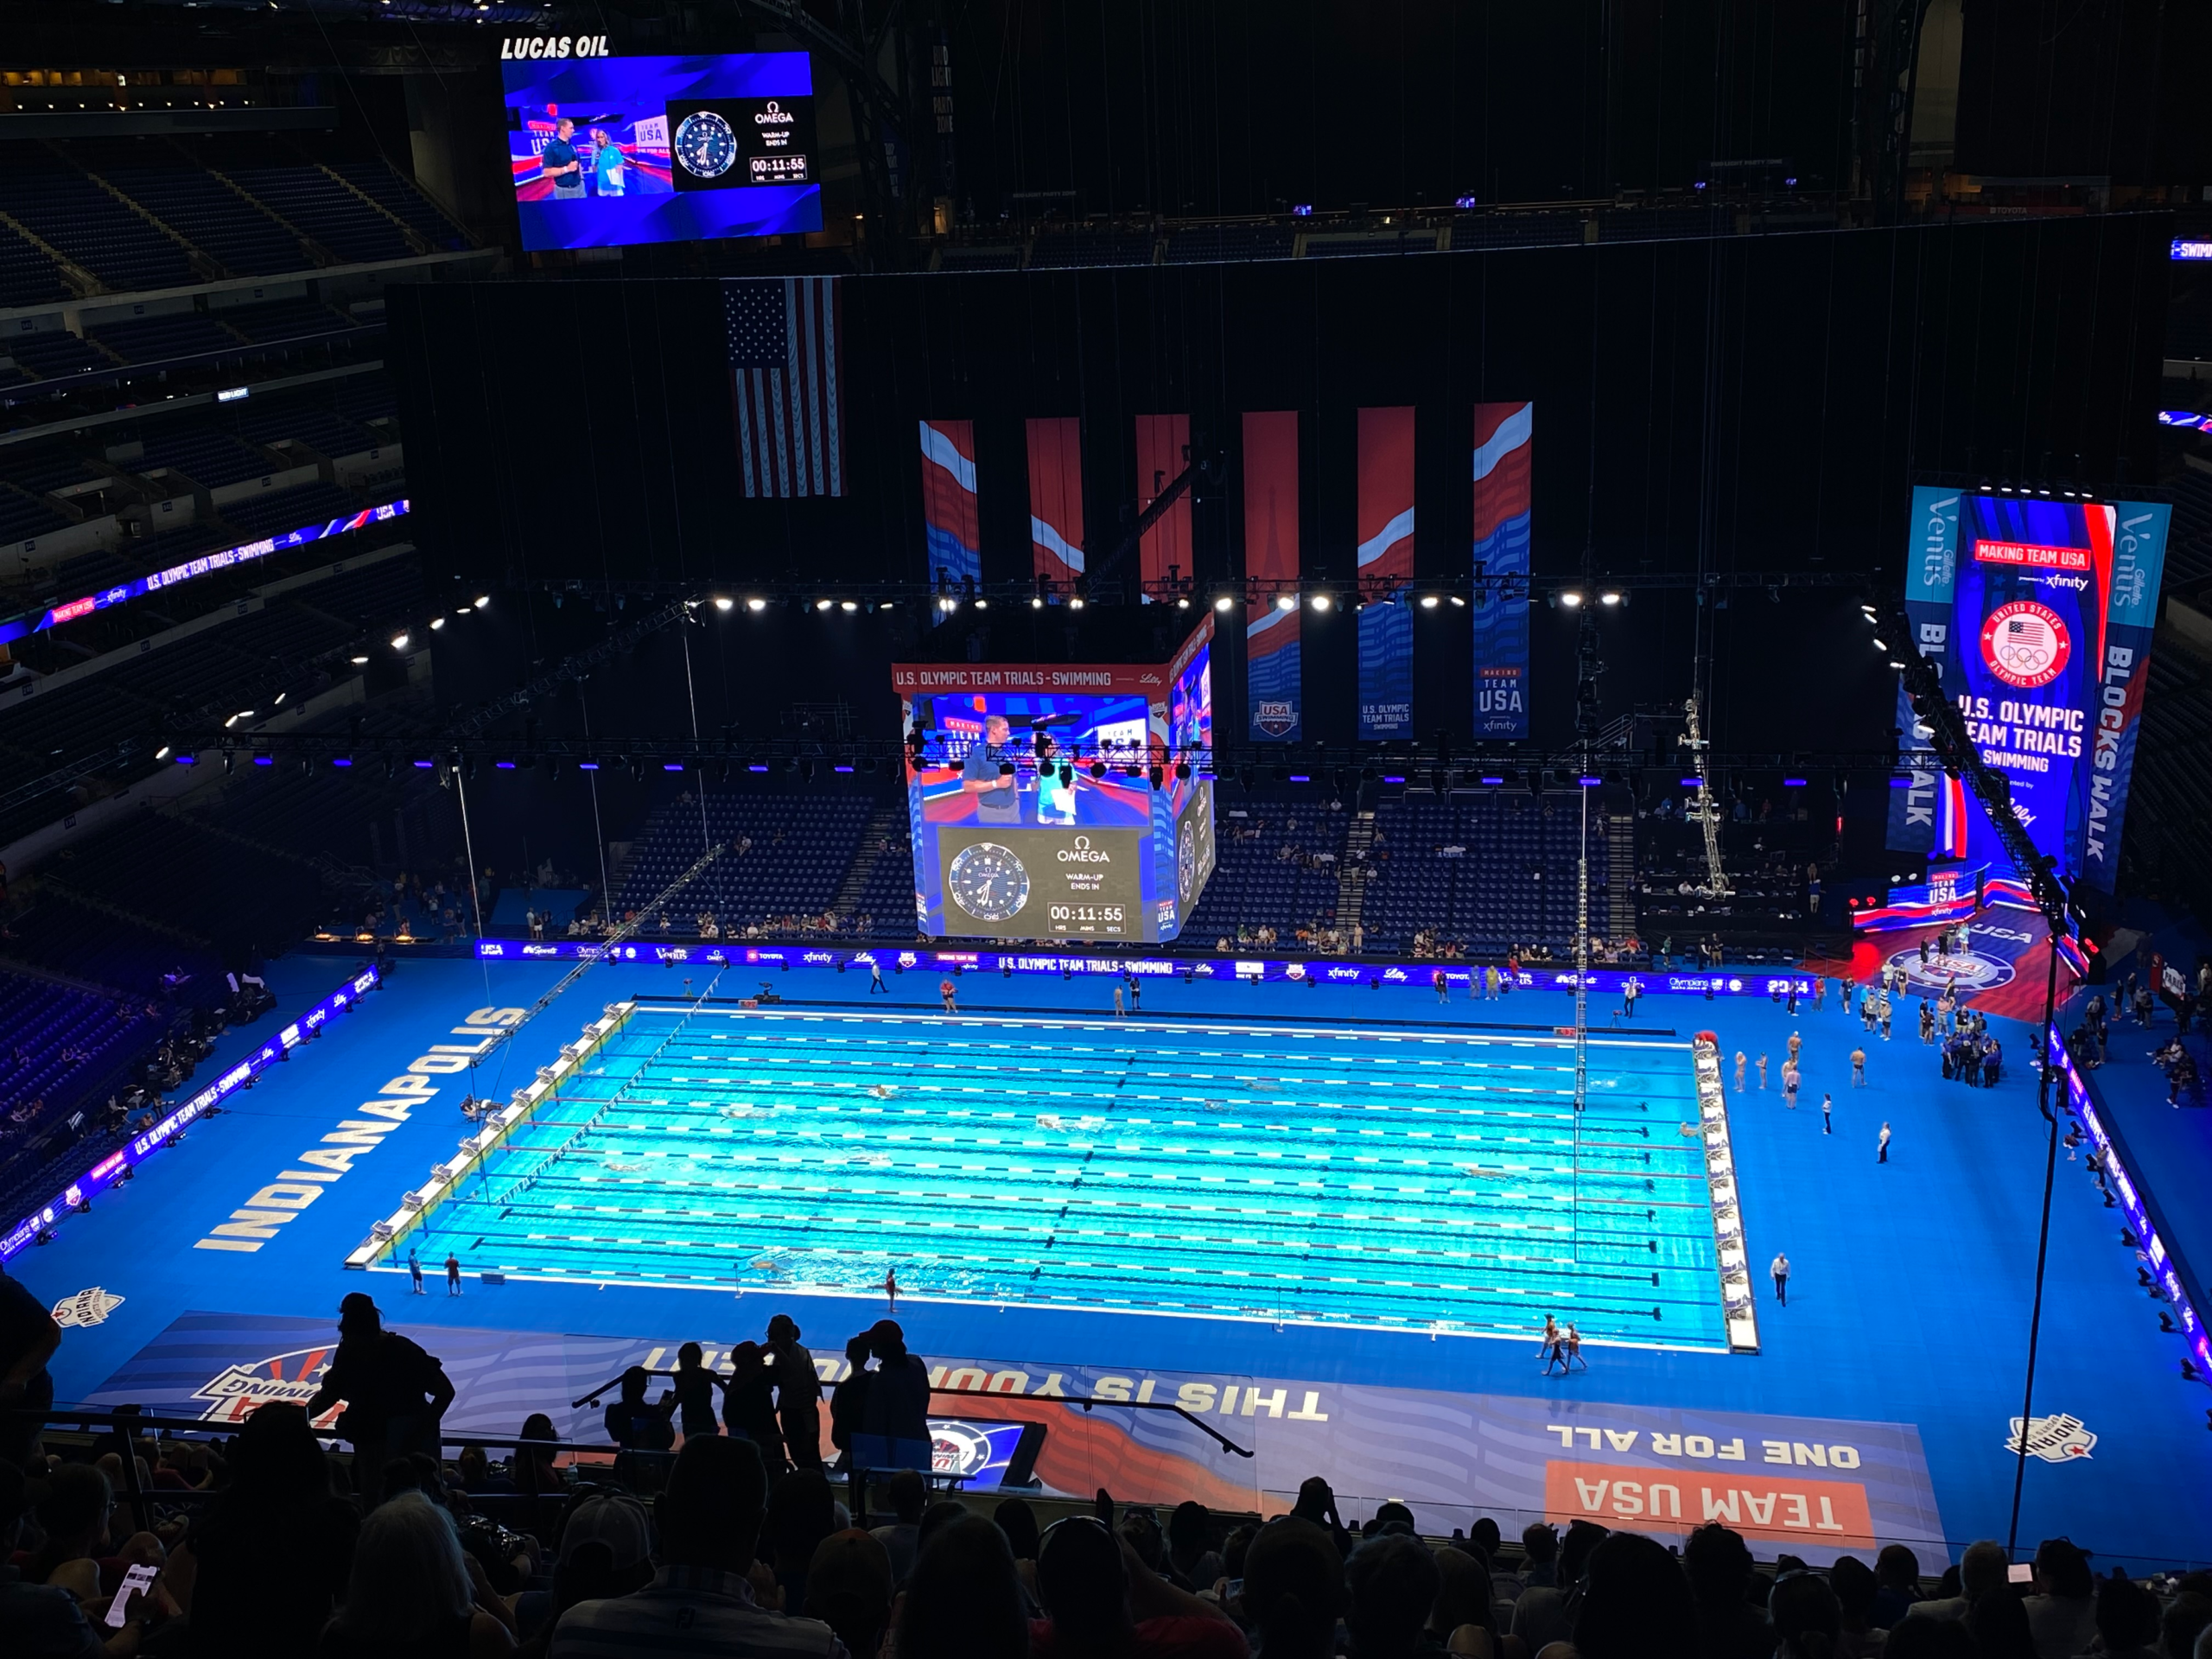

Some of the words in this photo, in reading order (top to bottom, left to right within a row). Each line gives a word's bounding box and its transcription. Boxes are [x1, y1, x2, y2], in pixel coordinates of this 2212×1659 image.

[501, 37, 571, 59] LUCAS
[576, 36, 608, 56] OIL
[755, 112, 794, 124] OMEGA
[640, 129, 663, 142] USA
[752, 158, 805, 172] 00:11:55
[376, 504, 395, 520] USA
[1980, 544, 2024, 561] MAKING
[2027, 549, 2057, 564] TEAM
[2061, 552, 2086, 567] USA
[162, 563, 189, 586] OLYMPIC
[189, 556, 208, 576] TEAM
[2046, 574, 2088, 591] xfinity
[1993, 604, 2026, 623] UNITED
[2030, 605, 2062, 630] STATES
[896, 671, 918, 685] U.S.
[920, 671, 967, 685] OLYMPIC
[970, 671, 1001, 685] TEAM
[1004, 671, 1044, 685] TRIALS
[1052, 672, 1111, 686] SWIMMING
[1139, 673, 1162, 687] Lilly
[1989, 660, 2026, 685] OLYMPIC
[2032, 667, 2057, 685] TEAM
[1484, 679, 1516, 689] TEAM
[1263, 705, 1288, 716] USA
[1363, 705, 1376, 714] U.S.
[1379, 703, 1409, 714] OLYMPIC
[1479, 690, 1522, 713] USA
[2094, 645, 2133, 770] BLOCKS
[1256, 714, 1296, 723] SWIMMING
[1363, 714, 1382, 723] TEAM
[1384, 713, 1409, 722] TRIALS
[1484, 721, 1517, 732] xfinity
[2000, 701, 2084, 733] OLYMPIC
[1963, 721, 2006, 747] EAM
[2013, 727, 2082, 758] TRIALS
[1983, 749, 2049, 772] SWIMMING
[2087, 775, 2113, 861] WALK
[1057, 850, 1110, 862] OMEGA
[1929, 887, 1956, 904] USA
[1051, 906, 1122, 921] 00:11:55
[1158, 910, 1175, 923] USA
[1969, 923, 2032, 944] USA
[481, 944, 503, 955] USA
[803, 951, 832, 963] xfinity
[1019, 958, 1057, 970] OLYMPIC
[1058, 958, 1084, 971] TEAM
[1086, 959, 1119, 973] TRIALS
[1125, 960, 1173, 974] SWIMMING
[1328, 968, 1360, 980] xfinity
[1669, 977, 1708, 987] Olympians
[1768, 980, 1808, 994] 204
[2164, 969, 2183, 990] PARIS
[149, 1116, 178, 1145] OLYMPIC
[176, 1103, 196, 1124] TEAM
[193, 1006, 526, 1252] INDIANAPOLIS
[76, 1288, 100, 1326] INDIANA
[1091, 1376, 1155, 1403] IS
[1179, 1382, 1329, 1421] THIS
[1547, 1426, 1638, 1452] ALL
[1651, 1433, 1745, 1461] FOR
[1764, 1440, 1861, 1469] ONE
[1573, 1478, 1681, 1519] USA
[1703, 1488, 1843, 1531] TEAM
